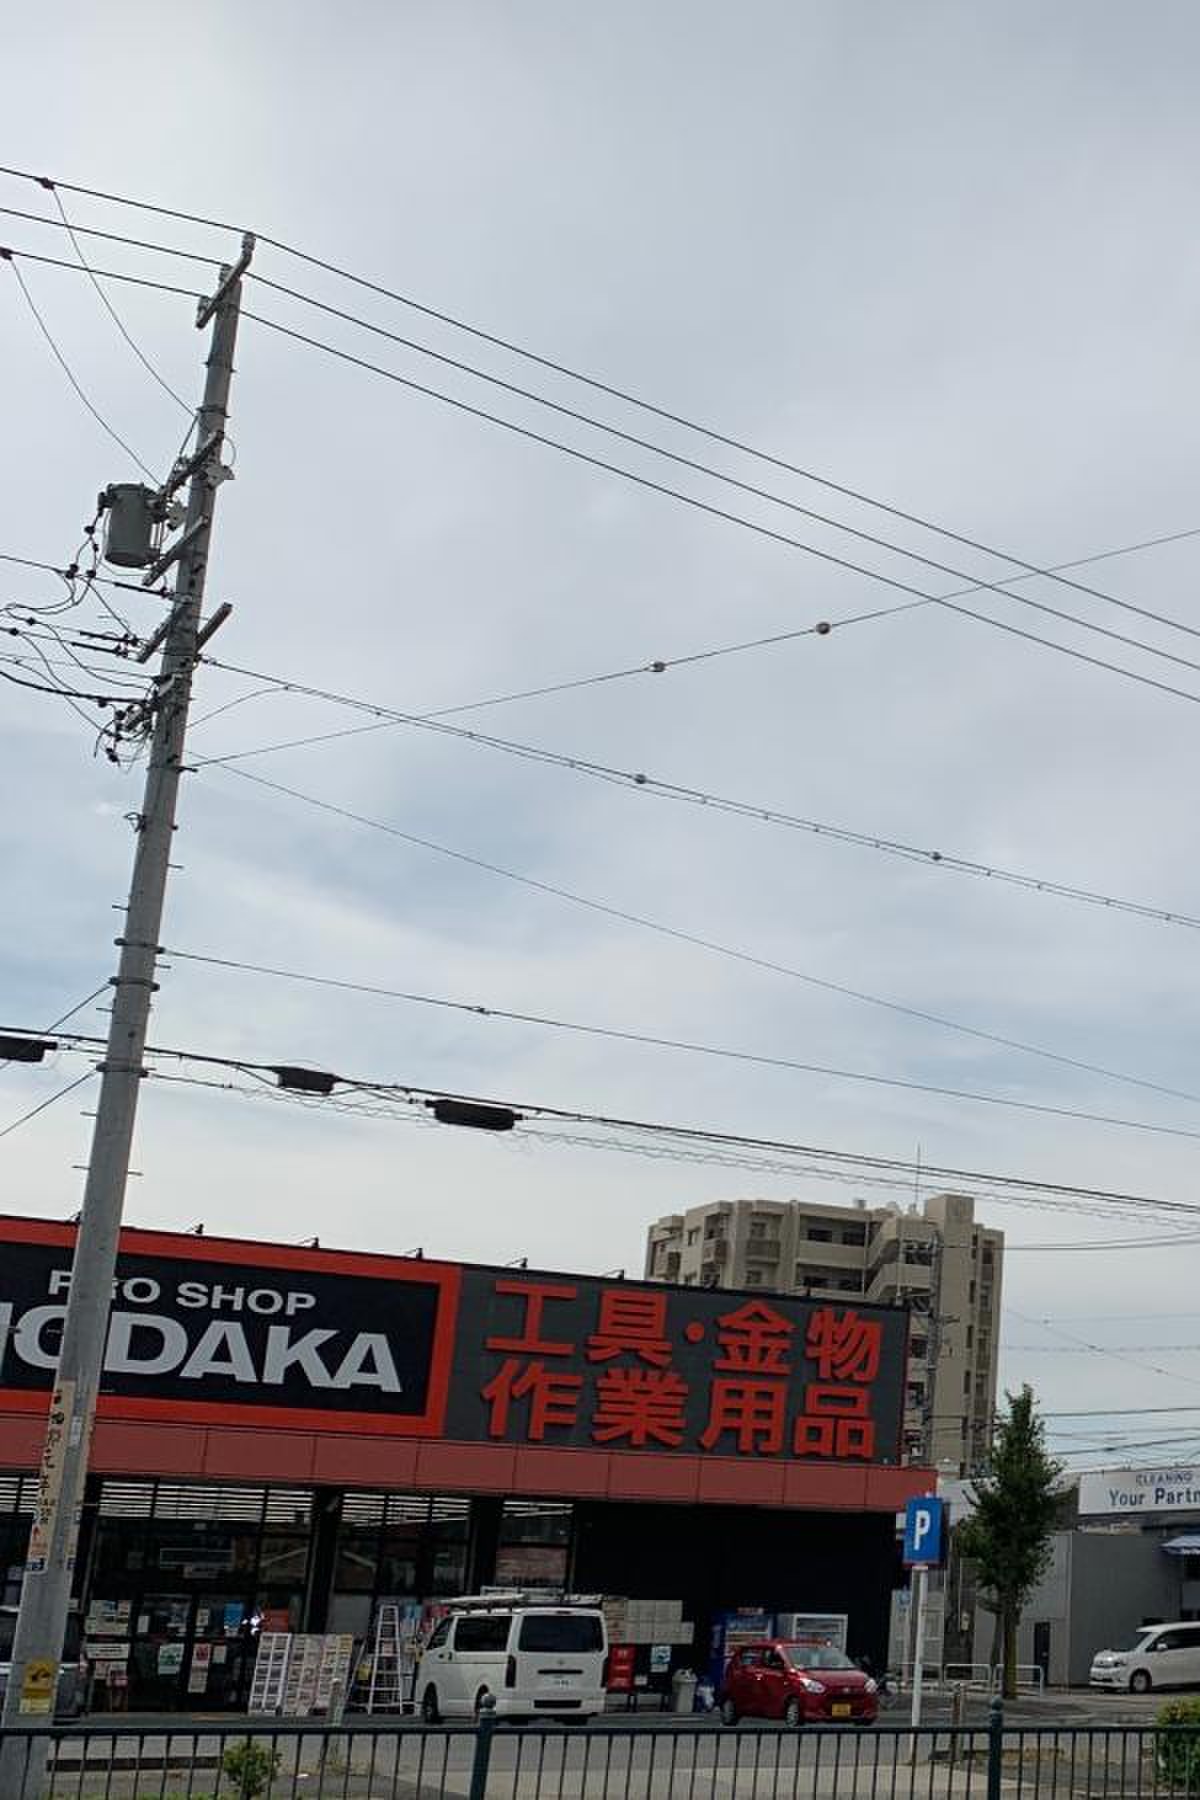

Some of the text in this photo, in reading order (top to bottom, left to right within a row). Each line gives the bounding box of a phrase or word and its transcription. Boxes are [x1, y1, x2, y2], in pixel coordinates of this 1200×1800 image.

[47, 1269, 318, 1317] PO SHOP
[0, 1299, 404, 1393] ODAKA
[485, 1279, 884, 1383] 工具・金物
[481, 1358, 876, 1459] 作業用品
[1108, 1488, 1146, 1507] Your
[1135, 1470, 1194, 1488] CLEANING
[913, 1510, 931, 1551] P
